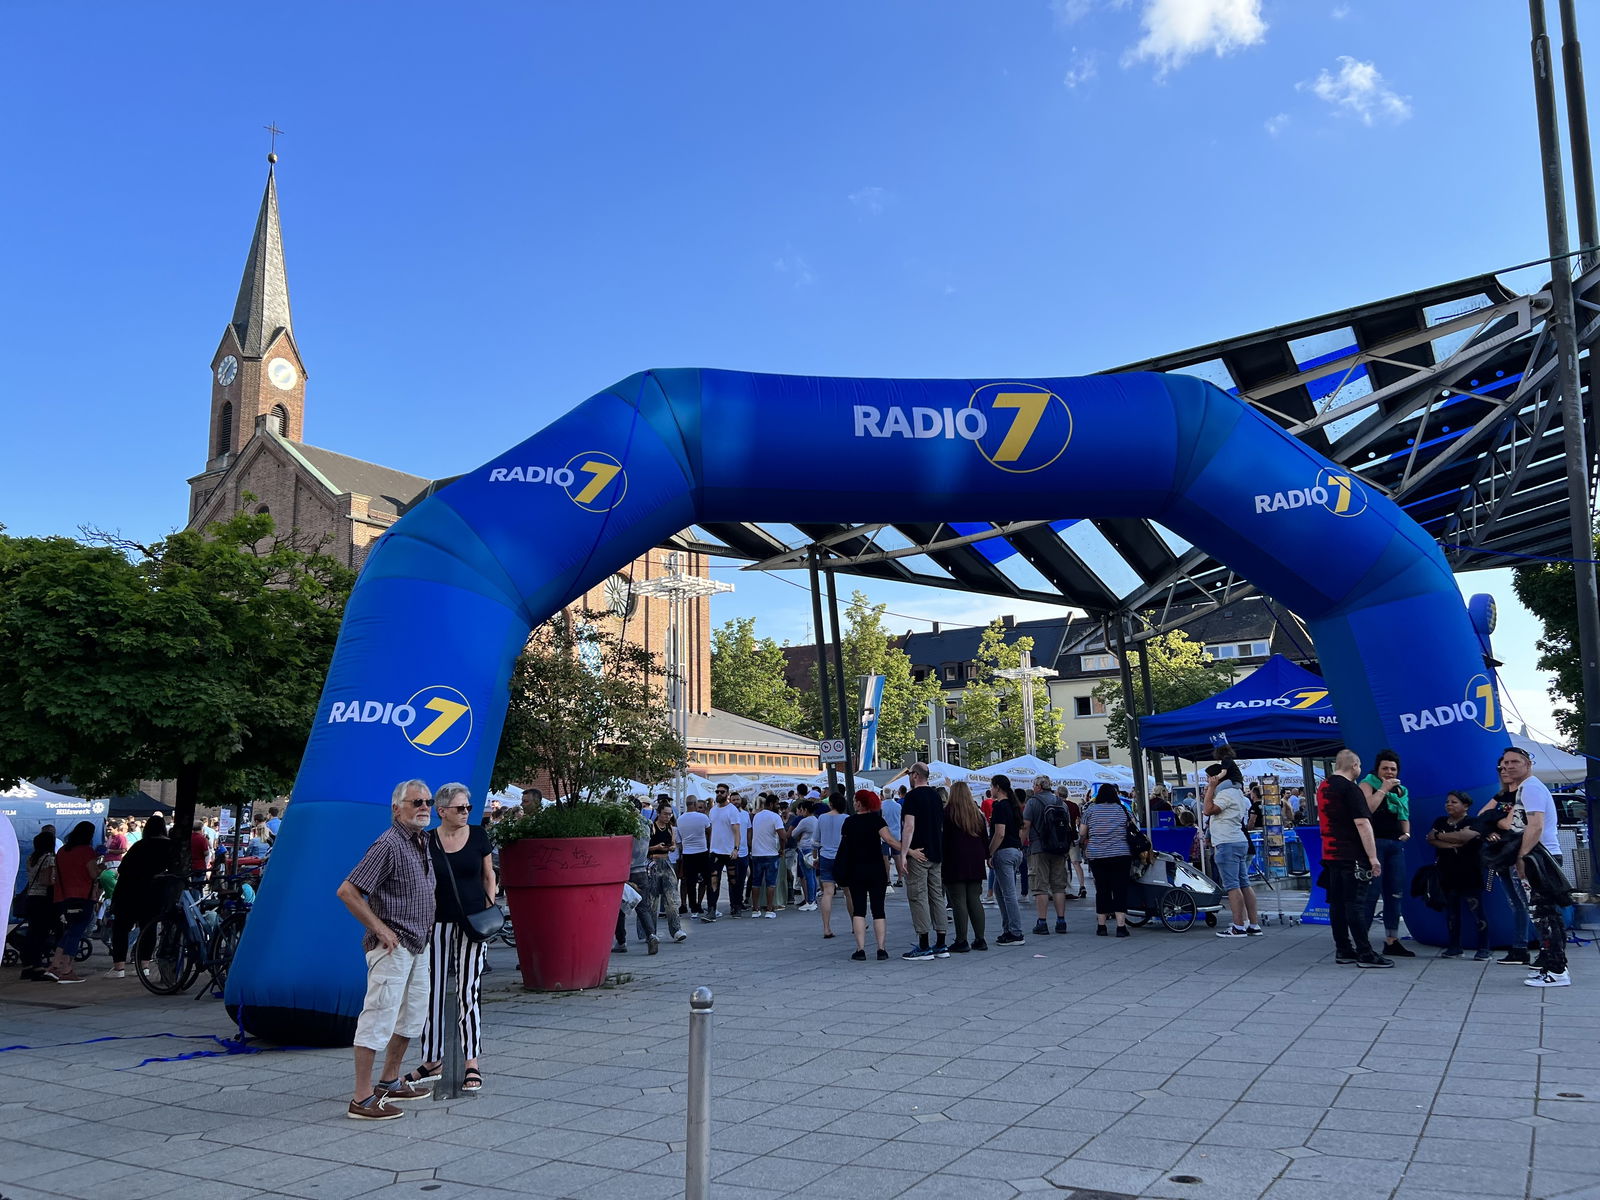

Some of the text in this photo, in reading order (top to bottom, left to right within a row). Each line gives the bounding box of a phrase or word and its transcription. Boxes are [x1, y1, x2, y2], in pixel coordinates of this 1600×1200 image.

[853, 393, 1051, 461] RADIO 7
[489, 461, 622, 504] RADIO 7
[1255, 475, 1351, 514] RADIO 7
[328, 697, 469, 746] RADIO 7
[1216, 690, 1329, 709] RADIO 7
[1400, 683, 1495, 733] RADIO 7
